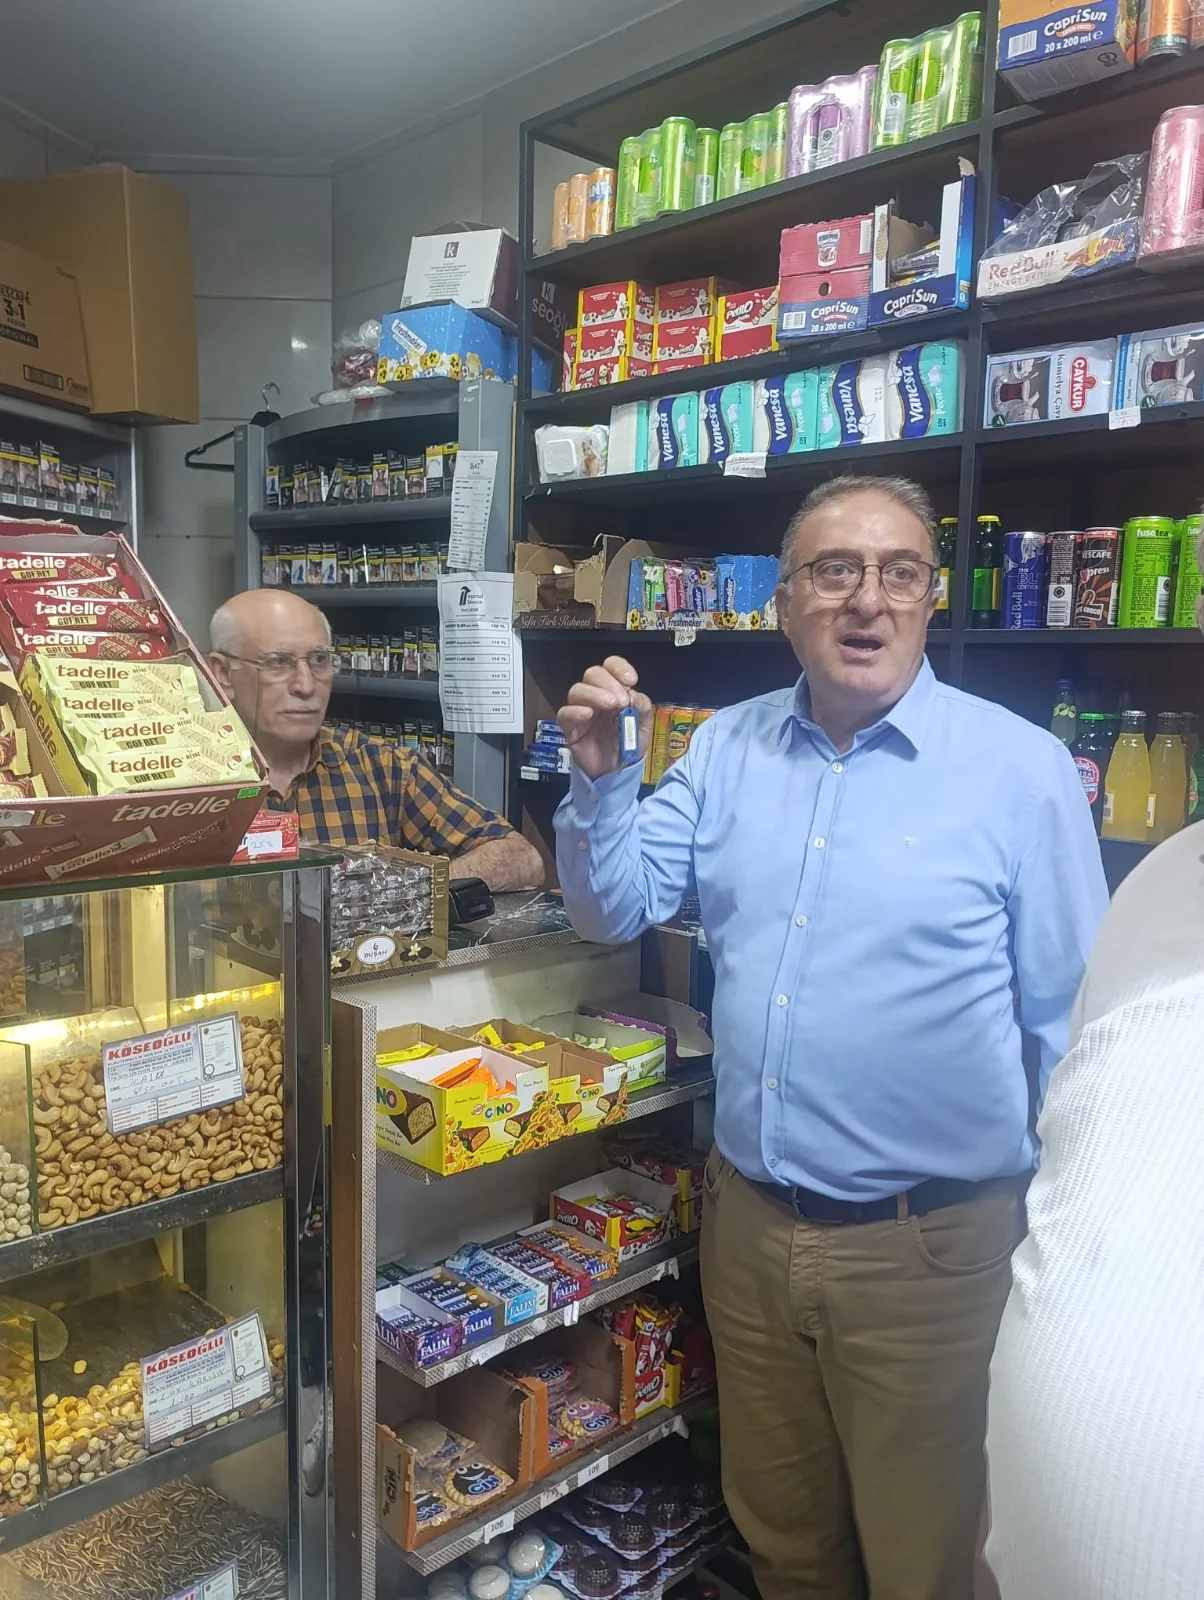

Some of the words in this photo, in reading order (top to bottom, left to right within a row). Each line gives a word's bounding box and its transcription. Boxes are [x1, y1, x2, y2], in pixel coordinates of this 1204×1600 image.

[1044, 42, 1055, 53] 20
[1063, 35, 1079, 47] 200
[1080, 32, 1091, 44] ml
[811, 302, 859, 321] CapriSun
[884, 288, 938, 316] CapriSun
[811, 323, 820, 333] 20
[825, 322, 842, 332] 200
[901, 364, 926, 424] Vanesa
[1071, 359, 1085, 409] ÇAYKUR
[769, 388, 789, 442] Vanesa
[837, 378, 860, 434] Vanesa
[660, 411, 675, 463] Vanesa
[709, 402, 726, 454] Vanesa
[34, 601, 106, 615] tadelle
[669, 616, 702, 628] Freshmaker
[23, 633, 96, 646] tadelle
[57, 665, 129, 679] tadelle
[62, 697, 134, 711] tadelle
[101, 722, 174, 740] tadelle
[109, 755, 183, 773] tadelle
[112, 797, 231, 823] tadelle
[108, 1031, 192, 1061] KÖSEOĞLU
[555, 1283, 580, 1300] FALIM
[510, 1300, 536, 1317] FALIM
[376, 1322, 401, 1351] ALIM
[463, 1317, 493, 1336] FALIM
[146, 1336, 224, 1376] KÖSEOĞLU
[421, 1337, 450, 1357] FALIM
